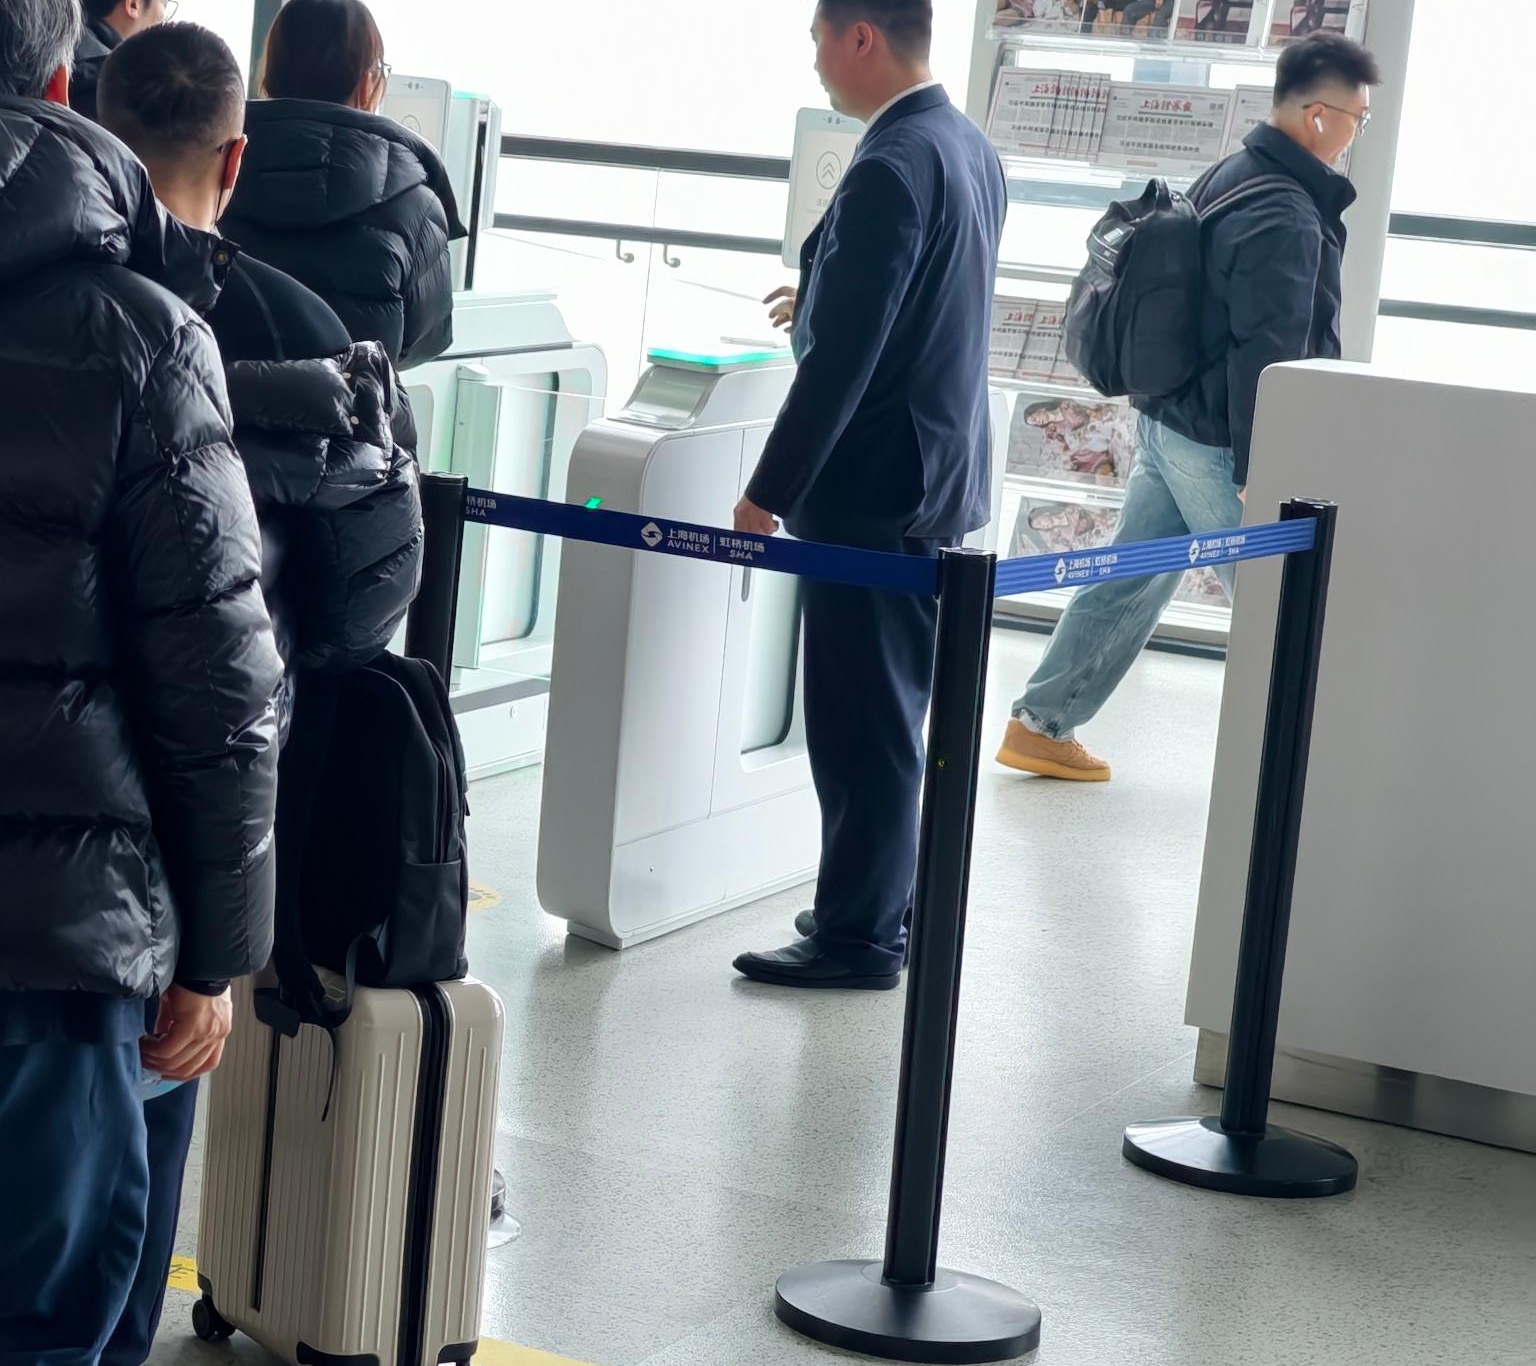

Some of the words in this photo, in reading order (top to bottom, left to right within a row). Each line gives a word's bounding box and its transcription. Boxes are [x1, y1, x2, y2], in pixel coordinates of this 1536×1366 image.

[667, 528, 710, 544] 上海机场
[719, 536, 765, 553] 虹桥机场
[667, 539, 710, 554] AVINEX
[729, 549, 753, 561] SHA
